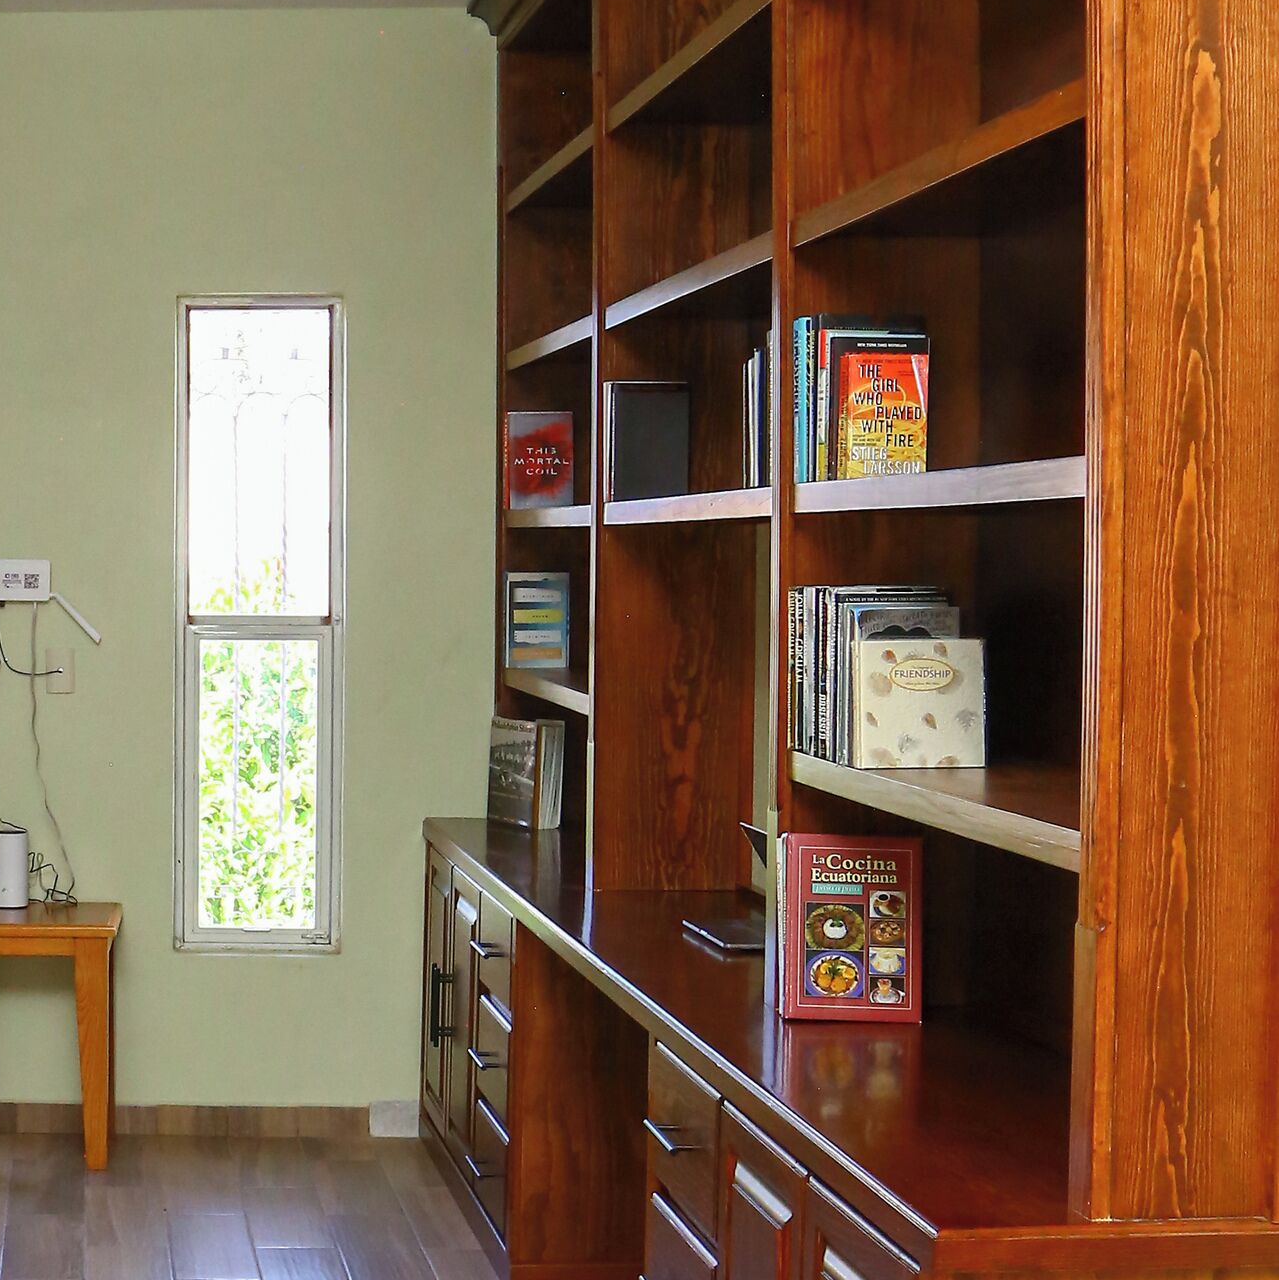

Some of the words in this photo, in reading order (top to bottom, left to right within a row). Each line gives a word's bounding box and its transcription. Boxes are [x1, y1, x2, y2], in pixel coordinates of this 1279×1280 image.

[858, 364, 882, 378] THE
[871, 379, 900, 392] GIRL
[853, 392, 883, 405] WHO
[875, 406, 921, 420] PLAYED
[862, 420, 893, 433] WITH
[886, 434, 914, 447] FIRE
[526, 447, 557, 455] THIS
[851, 447, 887, 460] STIEG
[514, 457, 570, 465] MORTAL
[864, 461, 920, 474] LARSSON
[526, 468, 558, 476] COIL
[796, 593, 804, 619] JOHN
[796, 638, 804, 683] GRISHAM
[894, 670, 951, 678] FRIENDSHIP
[812, 854, 825, 864] La
[826, 854, 897, 871] Cocina
[811, 867, 897, 884] Ecuatoriana
